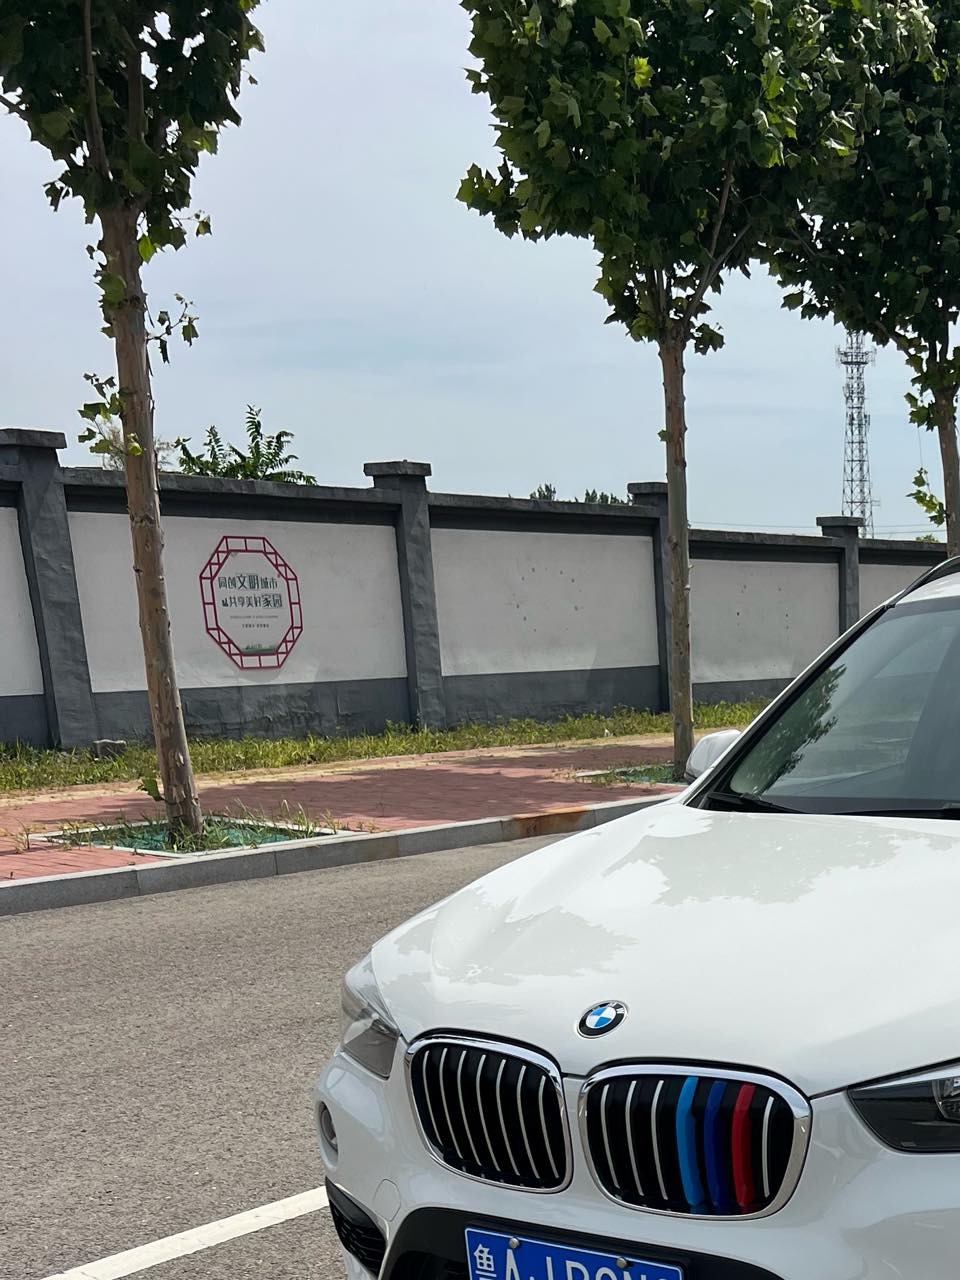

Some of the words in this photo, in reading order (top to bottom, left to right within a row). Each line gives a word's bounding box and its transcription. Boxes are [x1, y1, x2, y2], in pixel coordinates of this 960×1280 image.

[218, 574, 278, 590] 同创文明城市
[229, 594, 283, 608] 共享美好家园
